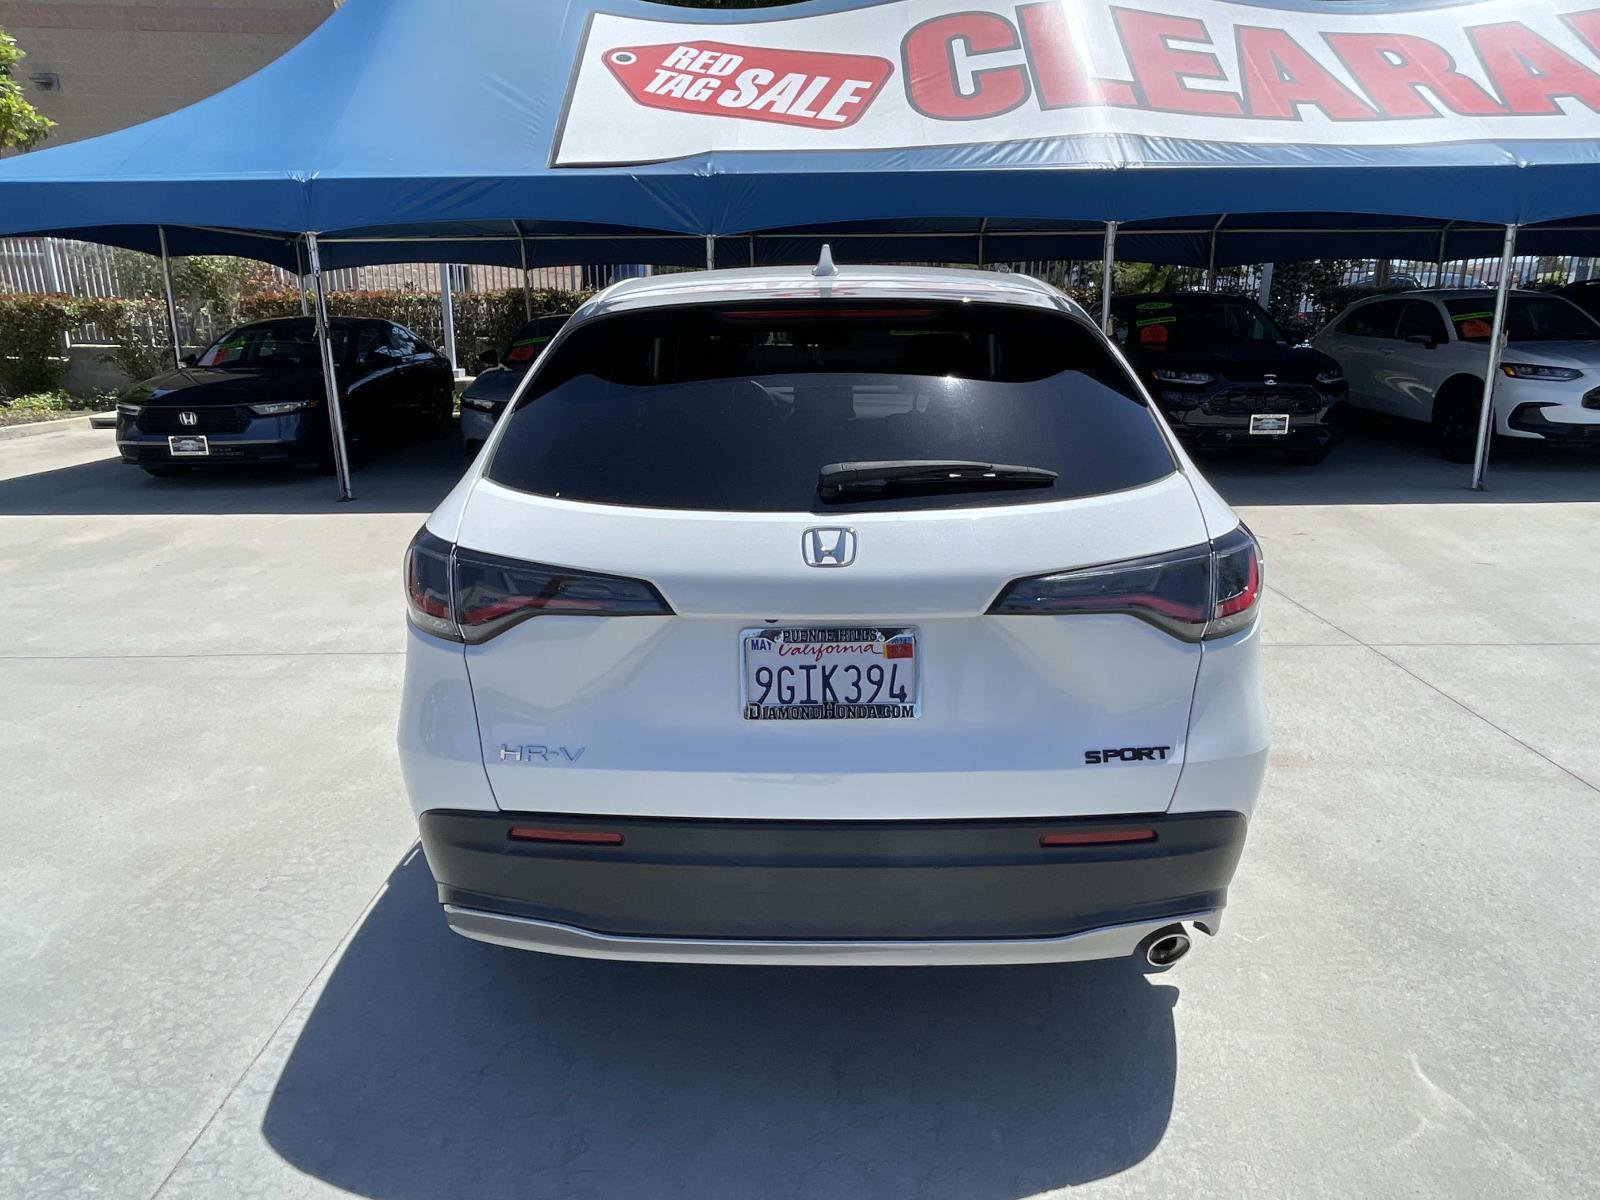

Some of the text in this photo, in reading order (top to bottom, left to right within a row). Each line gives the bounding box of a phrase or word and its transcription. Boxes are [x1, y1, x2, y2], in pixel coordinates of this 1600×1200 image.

[661, 45, 744, 76] RED
[899, 0, 1600, 122] CLEARA
[643, 69, 722, 101] TAG
[717, 68, 872, 122] SALE
[751, 639, 772, 650] MAY
[782, 628, 838, 643] PUENTE
[839, 628, 878, 642] HILLS
[779, 643, 883, 661] California
[755, 664, 908, 705] 9GIK394
[499, 744, 586, 763] HR-V
[1084, 746, 1170, 764] SPORT
